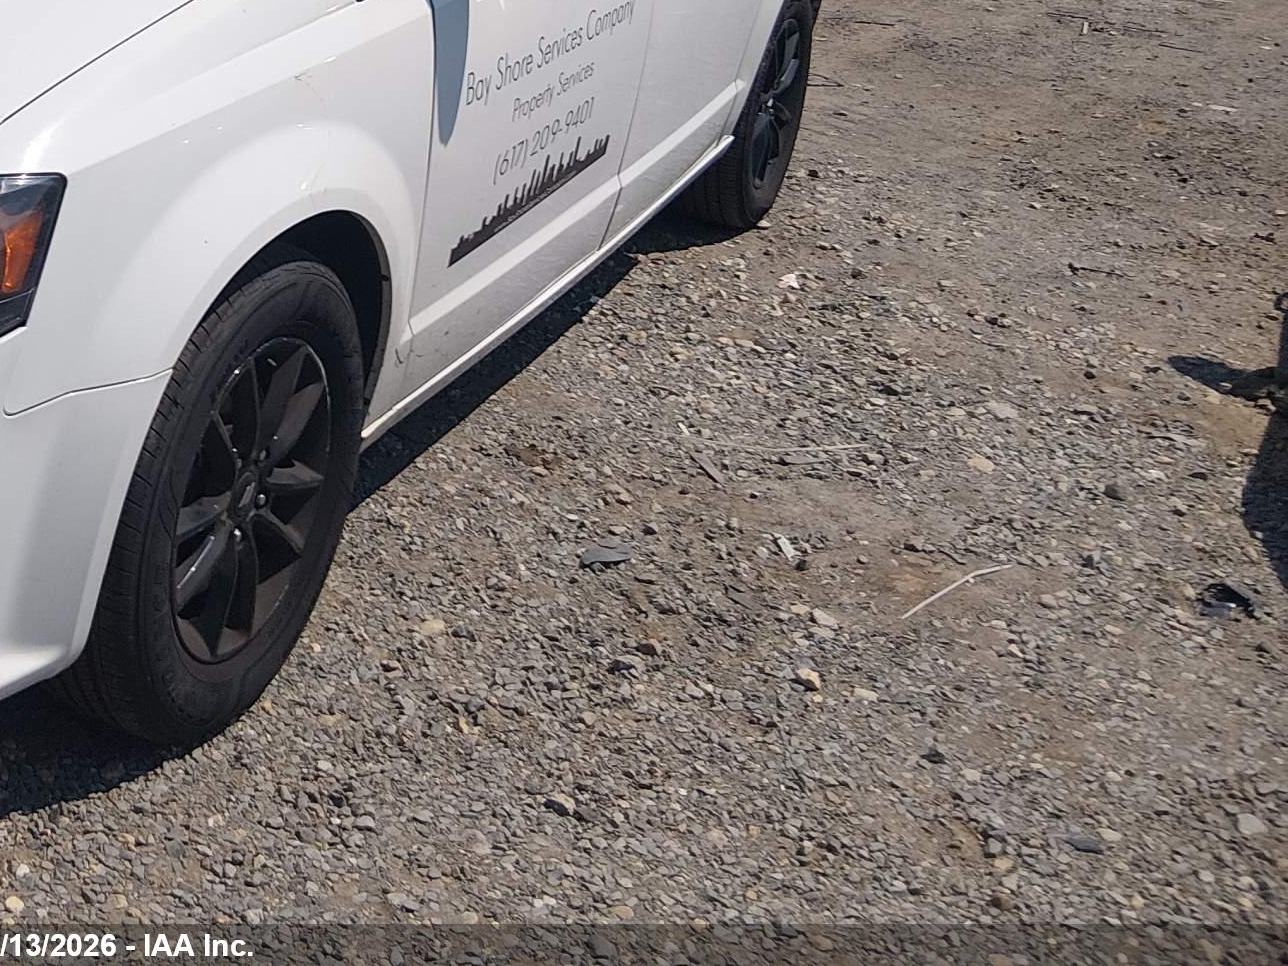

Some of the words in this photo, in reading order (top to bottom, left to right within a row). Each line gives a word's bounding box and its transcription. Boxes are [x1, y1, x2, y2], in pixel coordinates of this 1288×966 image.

[465, 71, 493, 106] Bay
[495, 53, 534, 90] Shore
[536, 28, 584, 68] Services
[511, 83, 555, 123] Property
[556, 60, 596, 94] Services
[492, 137, 530, 184] (617)
[529, 96, 596, 157] 209-9401
